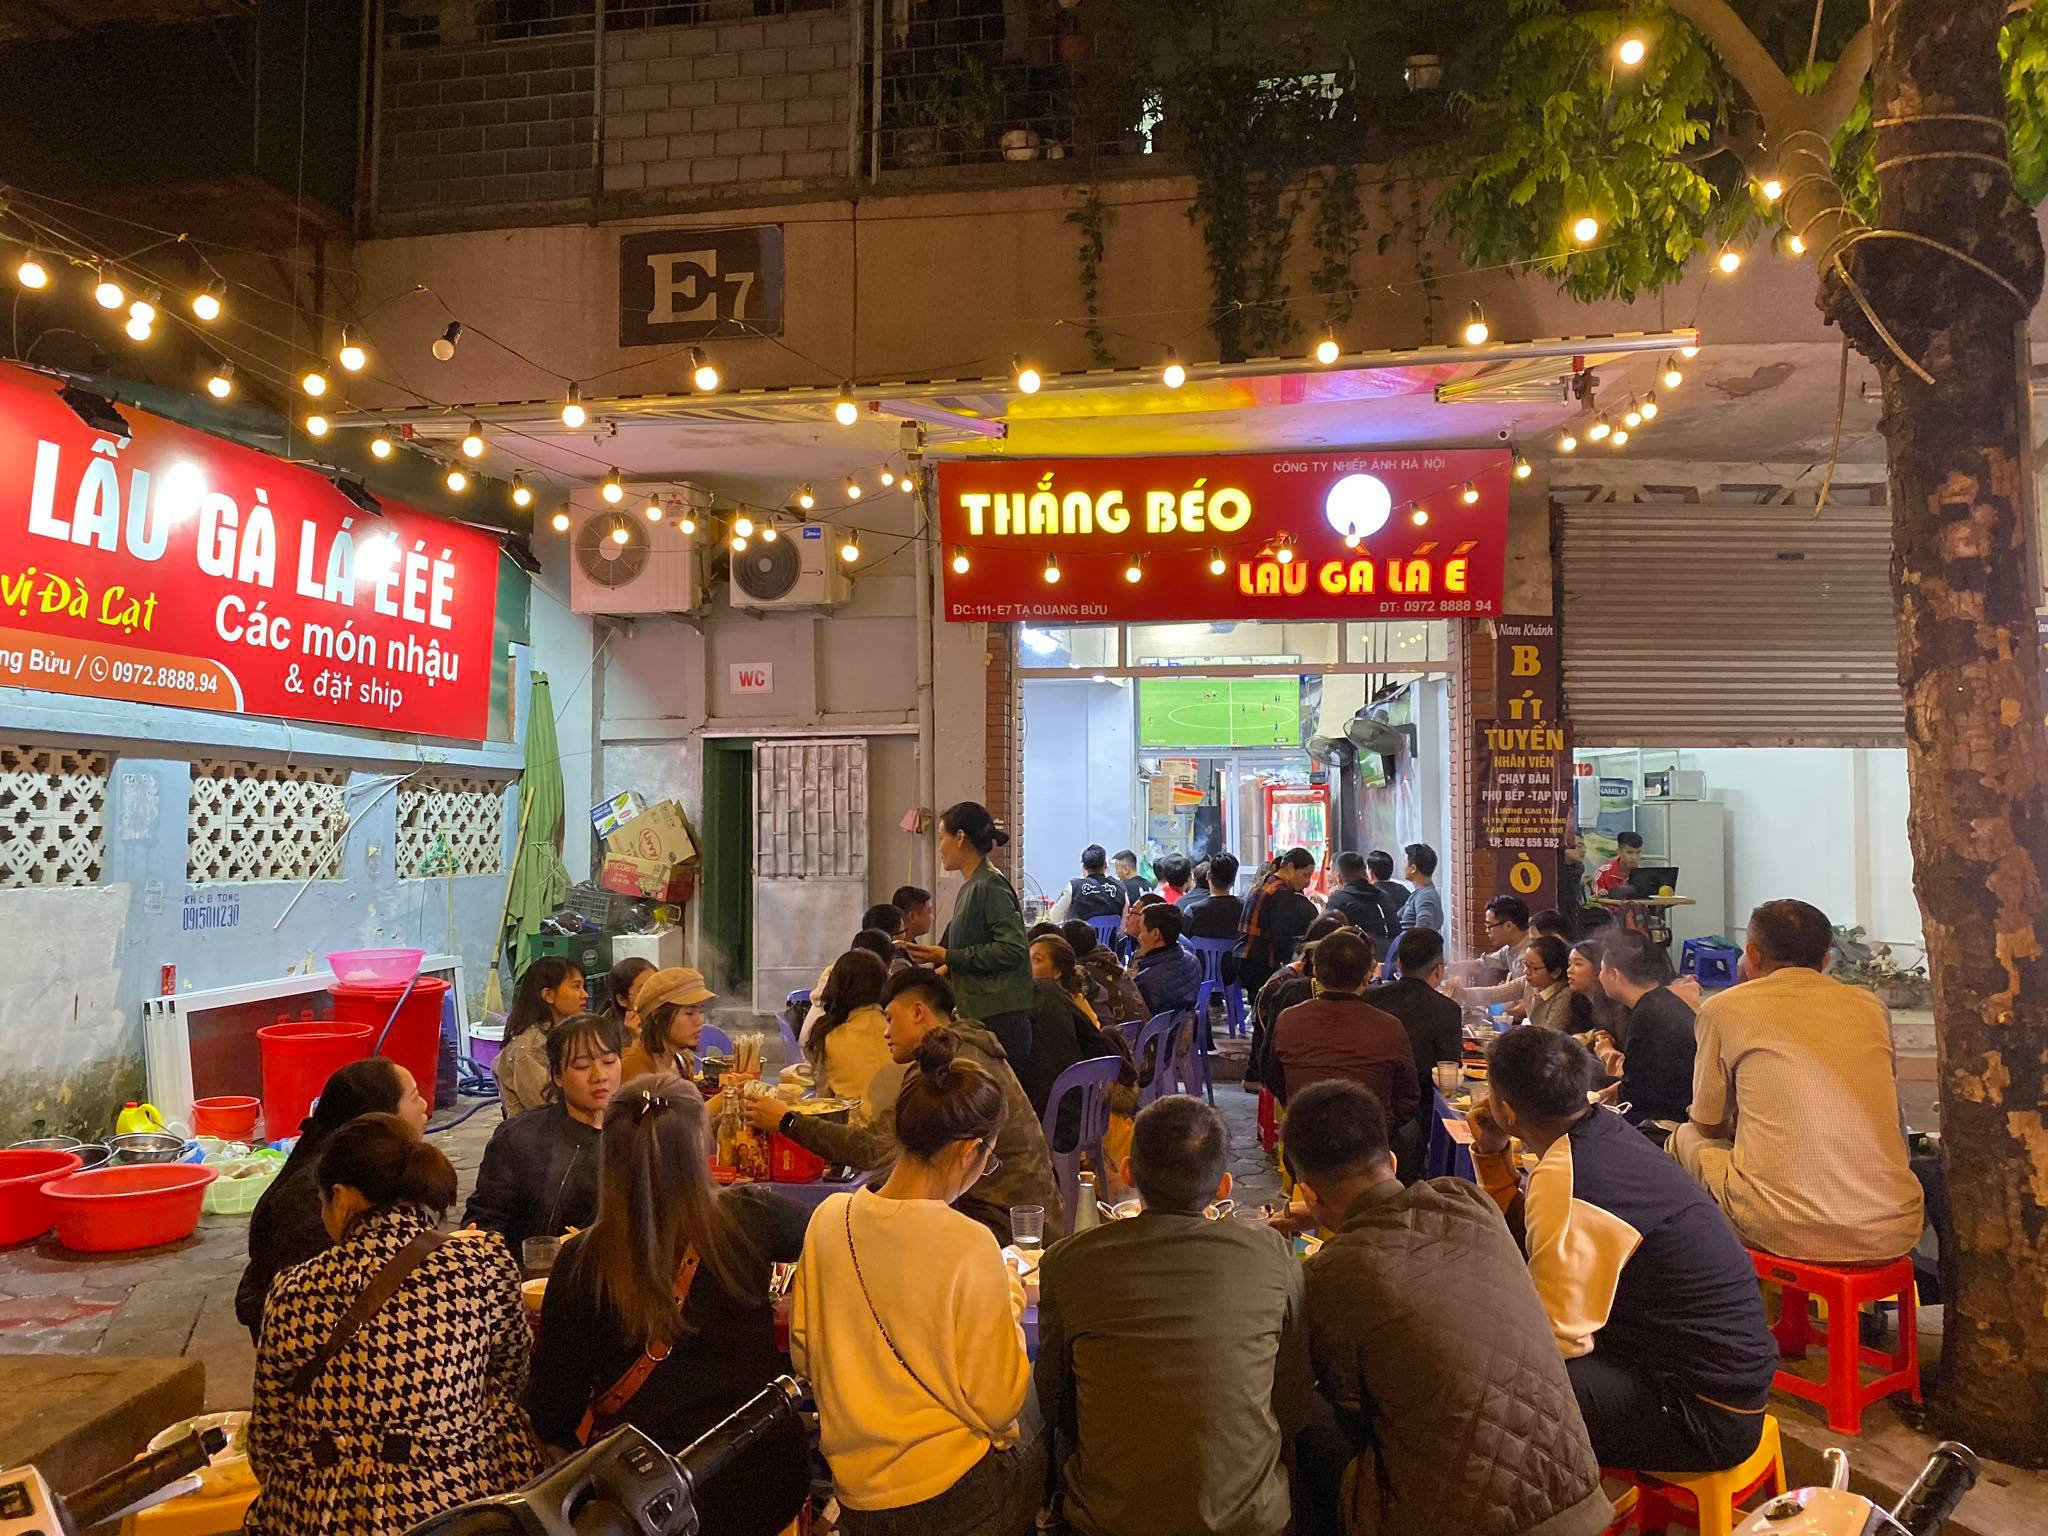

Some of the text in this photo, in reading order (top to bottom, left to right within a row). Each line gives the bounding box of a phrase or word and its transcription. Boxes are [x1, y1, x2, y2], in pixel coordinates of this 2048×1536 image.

[647, 249, 754, 324] E7
[1312, 461, 1328, 472] TY
[1401, 456, 1419, 469] HÀ
[1424, 455, 1446, 471] NỘI
[960, 472, 1252, 535] THẮNG BÉO
[197, 487, 276, 588] GÀ
[296, 516, 356, 607] LÁ
[1319, 542, 1376, 596] GÀ
[1387, 541, 1440, 595] LÁ
[1443, 540, 1479, 594] É
[0, 566, 159, 634] vị Đà Lạt
[1015, 603, 1031, 618] TẠ
[1033, 603, 1078, 616] QUANG
[1404, 601, 1435, 612] 0972
[1440, 600, 1471, 612] 8888
[1476, 600, 1492, 611] 94
[215, 594, 459, 687] Các món nhậu
[1499, 623, 1554, 636] Nam Khánh
[29, 648, 71, 676] Bửu
[74, 653, 88, 680] /
[112, 660, 218, 694] 0972.8888.94
[284, 663, 403, 714] & đặt ship
[738, 670, 765, 687] WC
[1484, 720, 1564, 751] TUYỂN
[1494, 753, 1554, 768] NHÂN VIÊN
[183, 903, 240, 931] 0915011230
